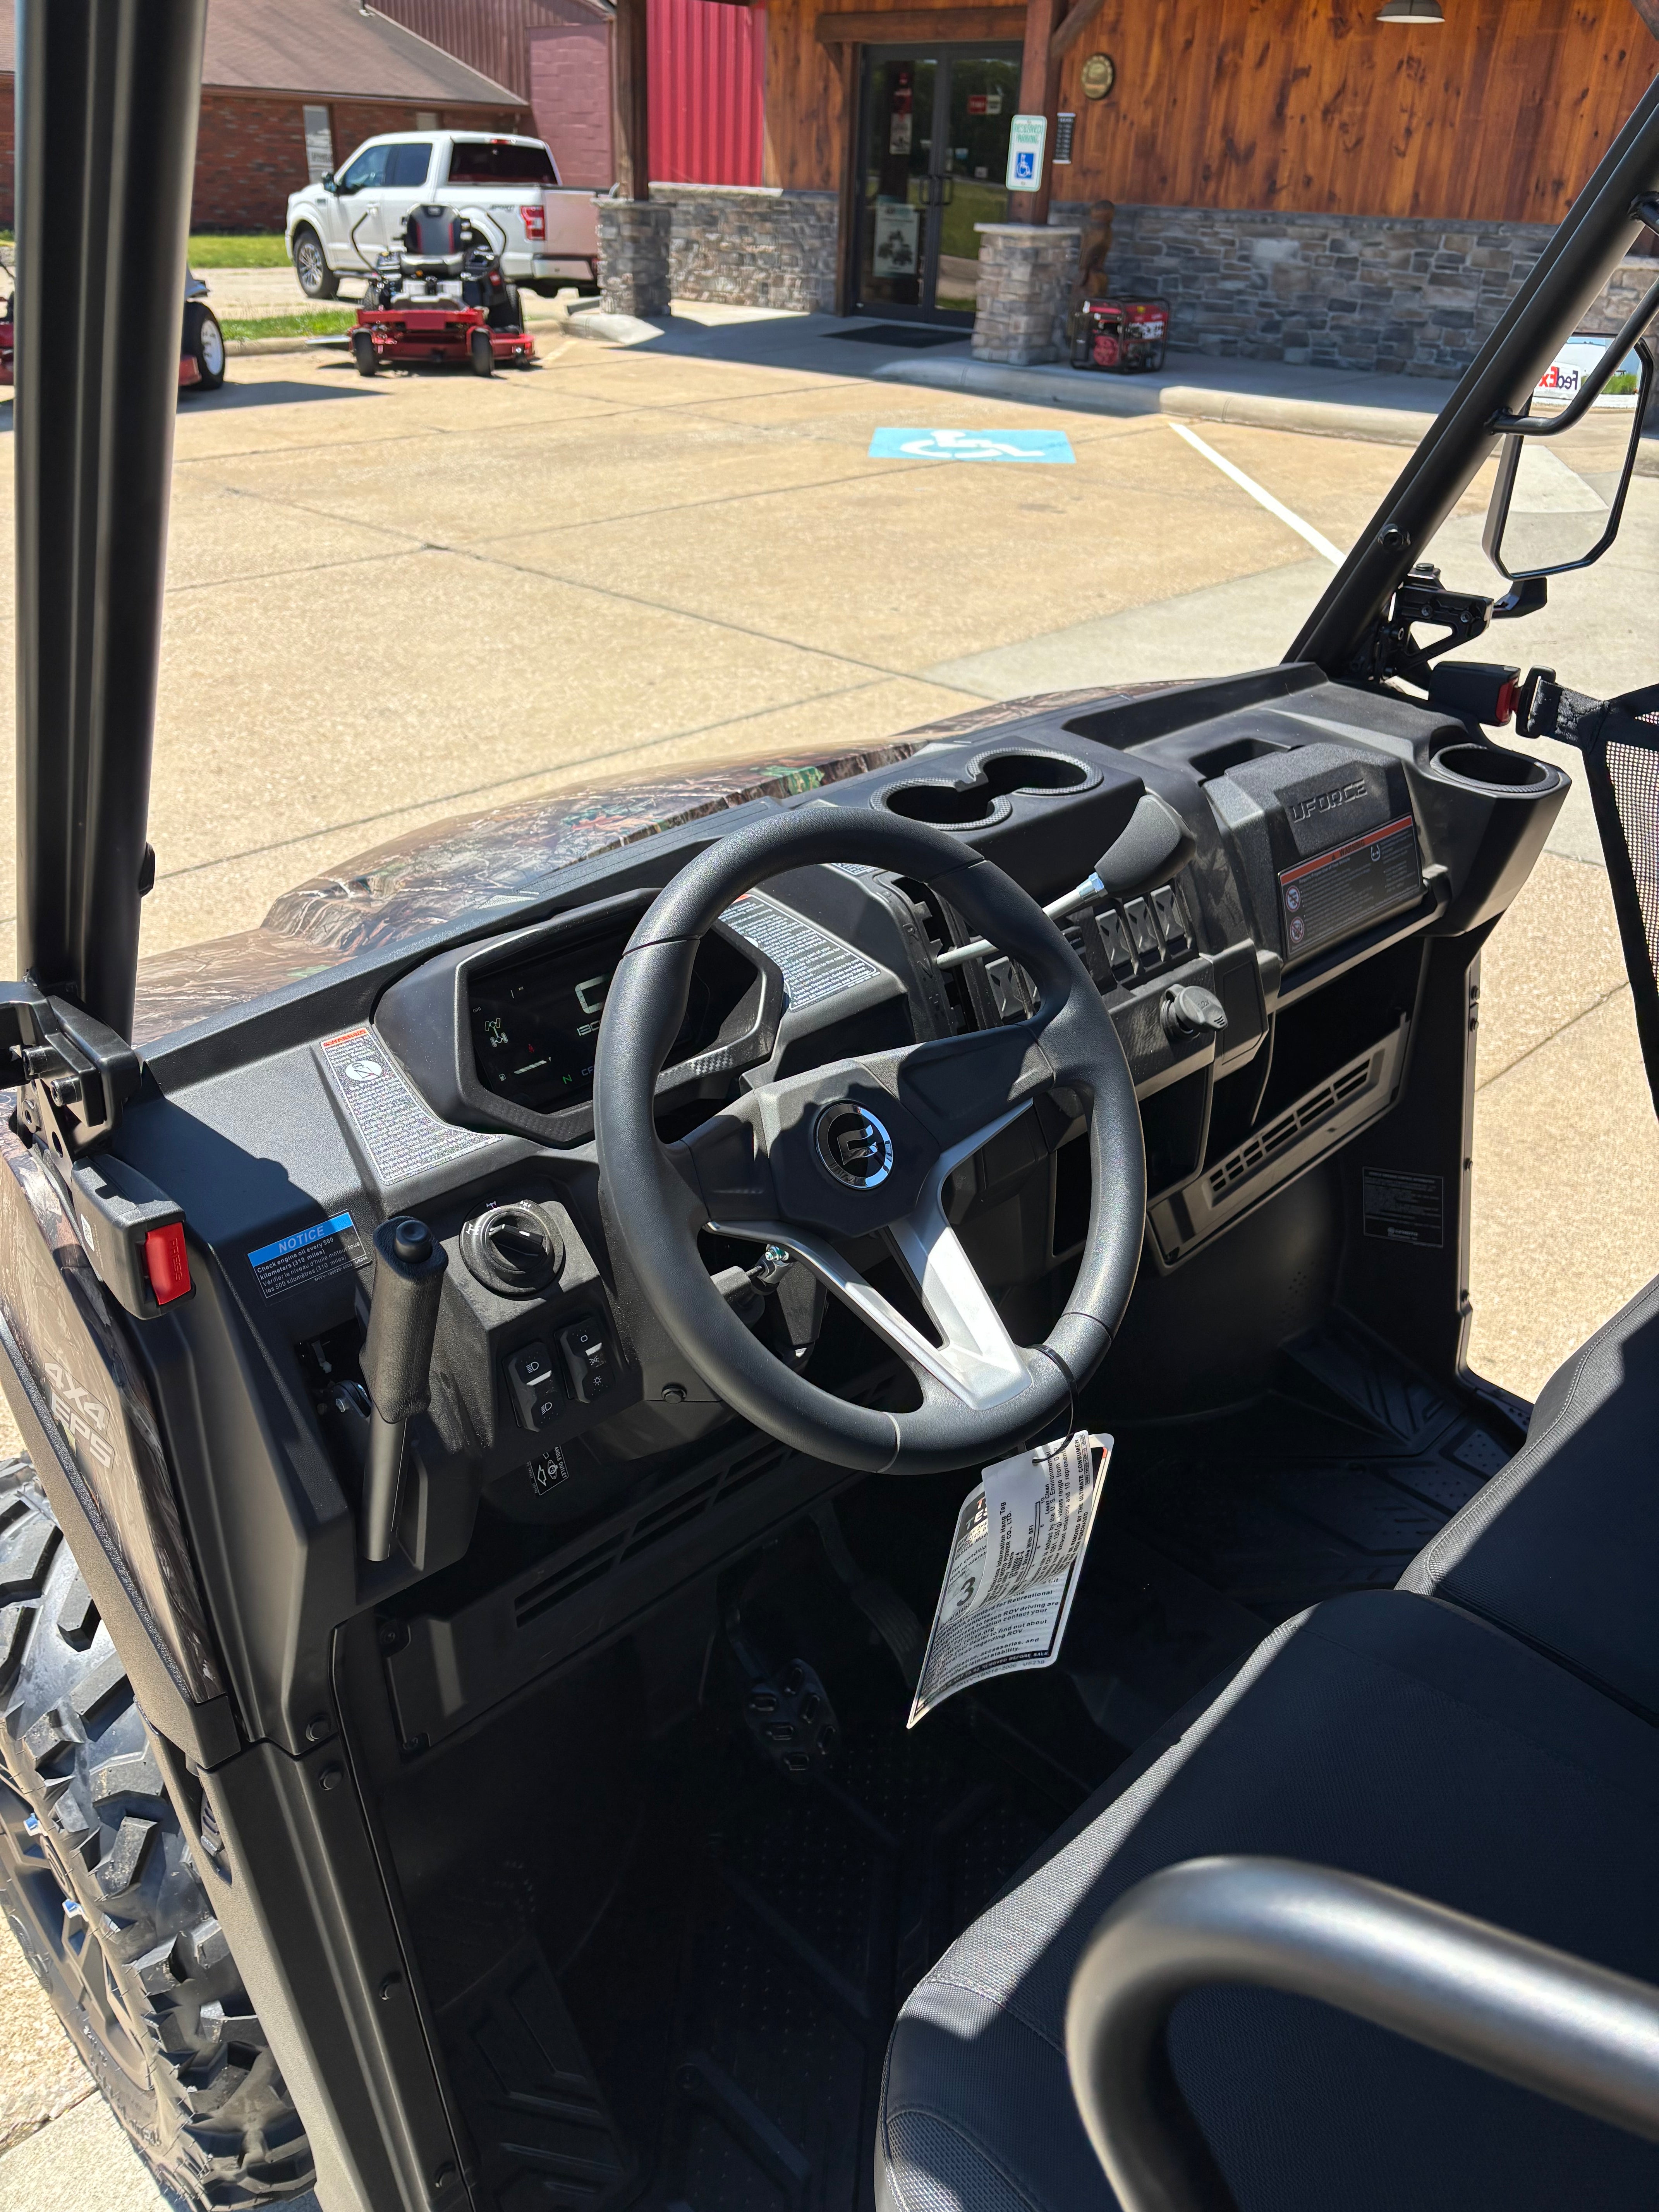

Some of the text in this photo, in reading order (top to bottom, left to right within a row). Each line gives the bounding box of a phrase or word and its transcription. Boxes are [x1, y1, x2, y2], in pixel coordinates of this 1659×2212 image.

[1291, 778, 1368, 823] UFORCE
[1340, 839, 1365, 856] WARNING
[577, 1020, 601, 1036] 130
[562, 1075, 572, 1084] N
[582, 1066, 594, 1076] CF
[279, 1225, 324, 1253] NOTICE
[170, 1238, 182, 1281] PRESS
[257, 1263, 276, 1273] Check
[277, 1253, 297, 1266] engine
[306, 1242, 323, 1253] every
[323, 1237, 334, 1245] 500
[260, 1249, 325, 1280] kilometers (310 miles)
[262, 1273, 284, 1286] Vérifier
[290, 1264, 309, 1274] niveau
[310, 1256, 328, 1266] d'huile
[328, 1247, 348, 1259] moteur
[348, 1242, 360, 1250] tous
[275, 1281, 286, 1290] 500
[316, 1263, 328, 1273] (310
[45, 1362, 106, 1432] 4X4
[52, 1389, 112, 1469] EPS
[558, 1462, 567, 1479] OUTLET
[963, 1545, 987, 1563] conditio
[957, 1577, 975, 1606] 3
[1007, 1590, 1053, 1605] Recreational
[1003, 1611, 1030, 1621] contact
[1020, 1602, 1046, 1612] driving
